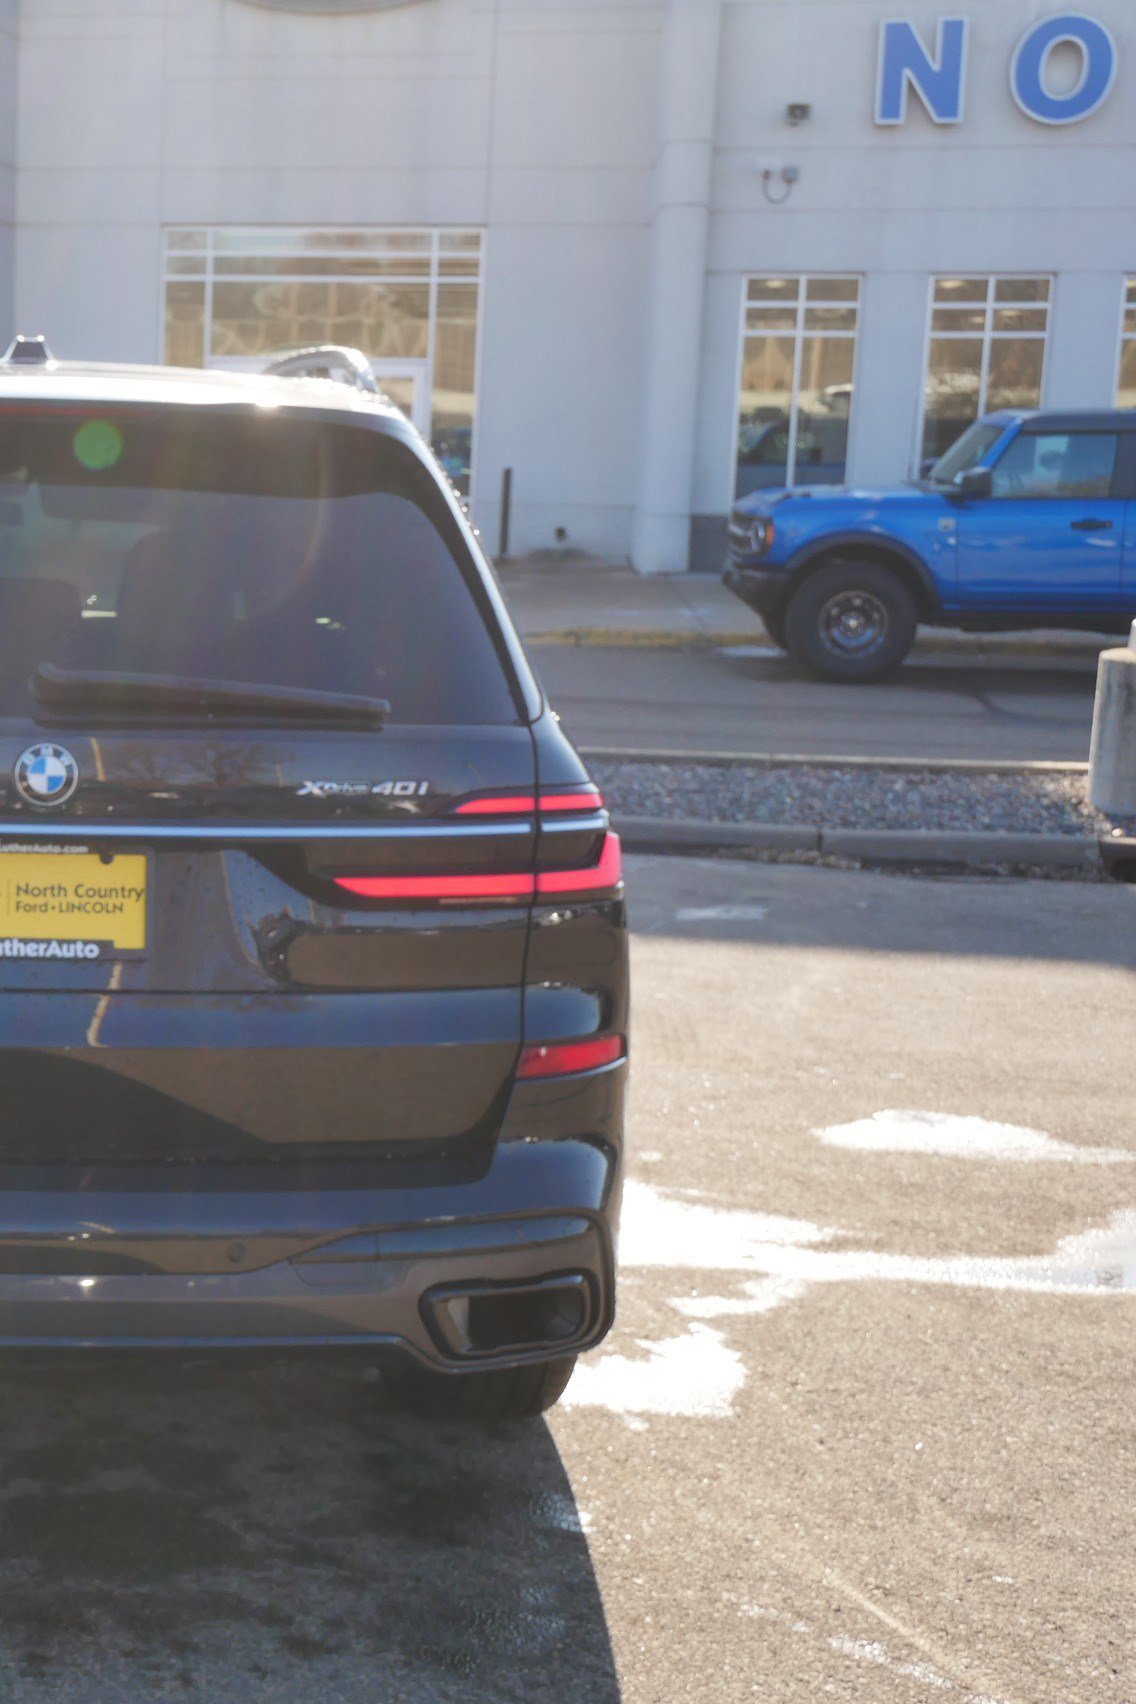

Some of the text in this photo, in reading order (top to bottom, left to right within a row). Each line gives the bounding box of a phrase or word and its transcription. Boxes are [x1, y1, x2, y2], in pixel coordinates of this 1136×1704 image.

[16, 883, 145, 902] North Country
[16, 901, 49, 913] Ford
